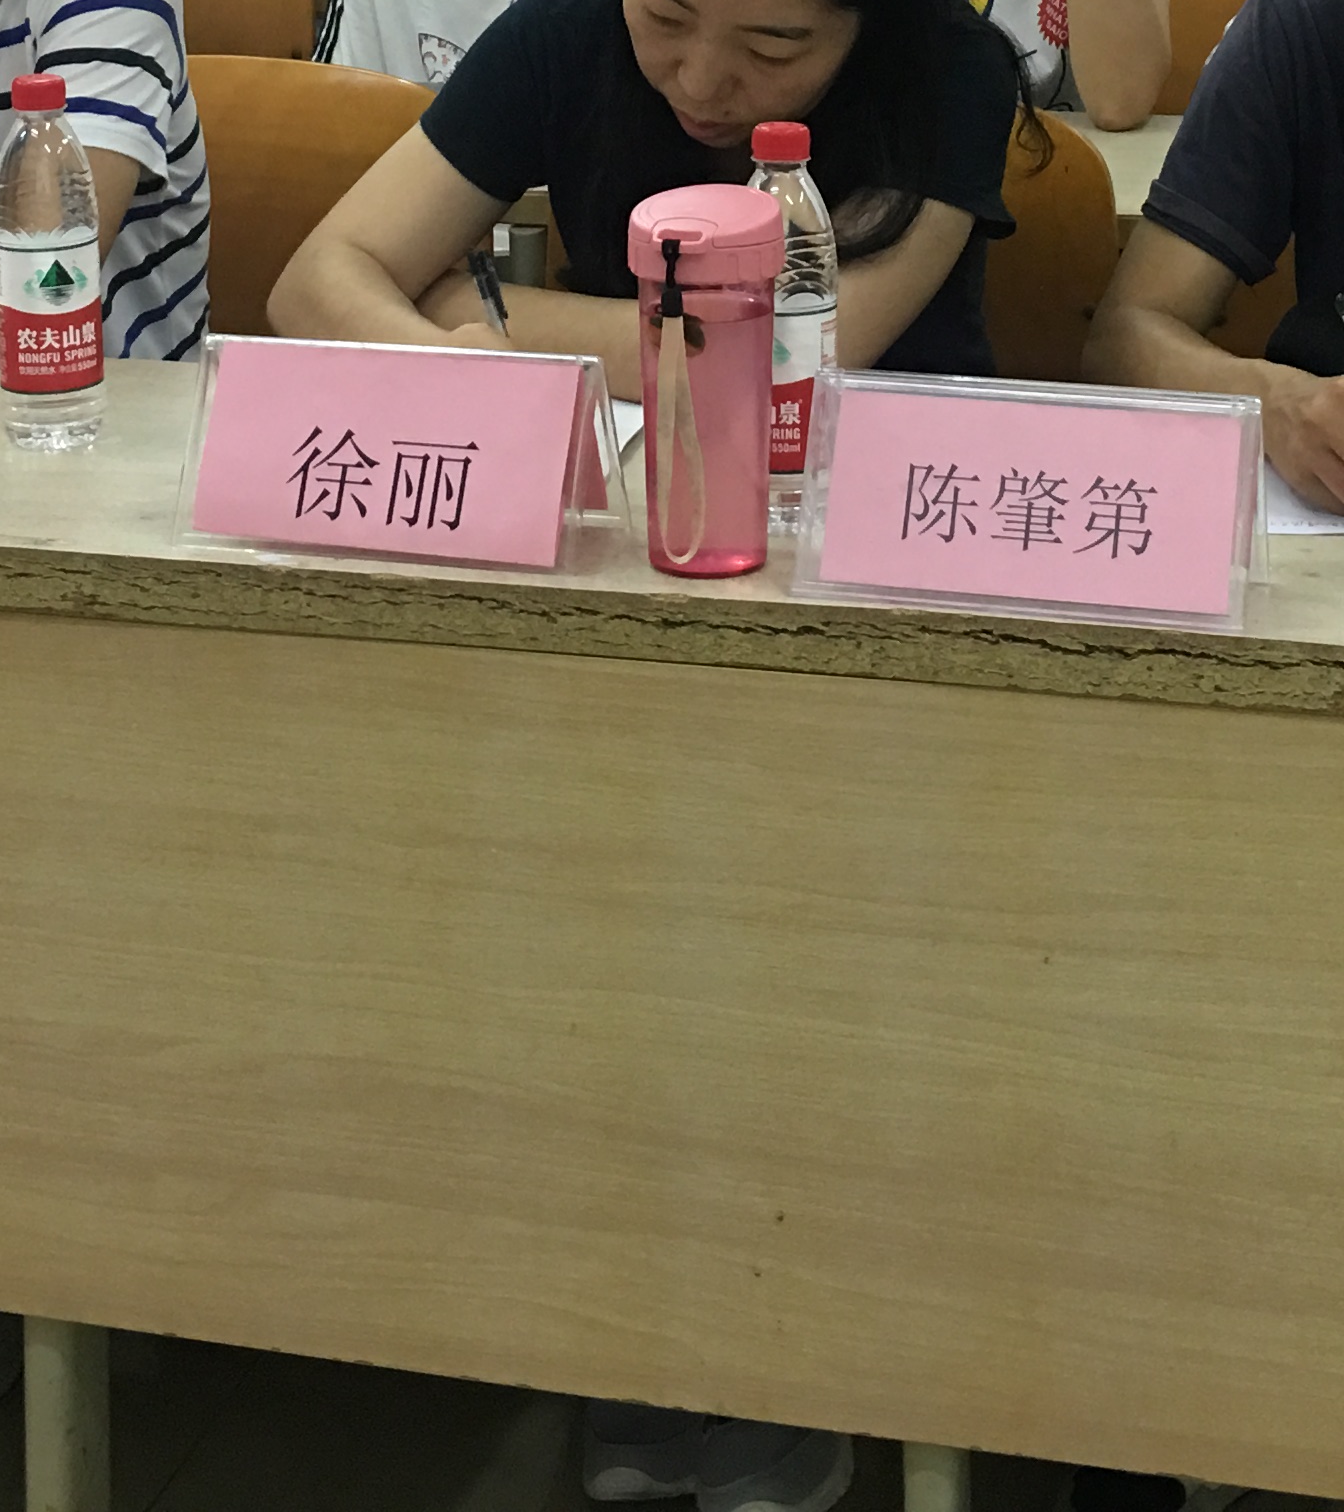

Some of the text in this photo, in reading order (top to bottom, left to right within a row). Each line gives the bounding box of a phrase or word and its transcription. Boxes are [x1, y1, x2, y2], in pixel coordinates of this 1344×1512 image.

[17, 321, 97, 350] 农夫山泉
[18, 345, 97, 364] NONGFU SPRING
[770, 428, 801, 440] RING
[287, 423, 481, 531] 徐丽
[901, 460, 1161, 560] 陈肇第
